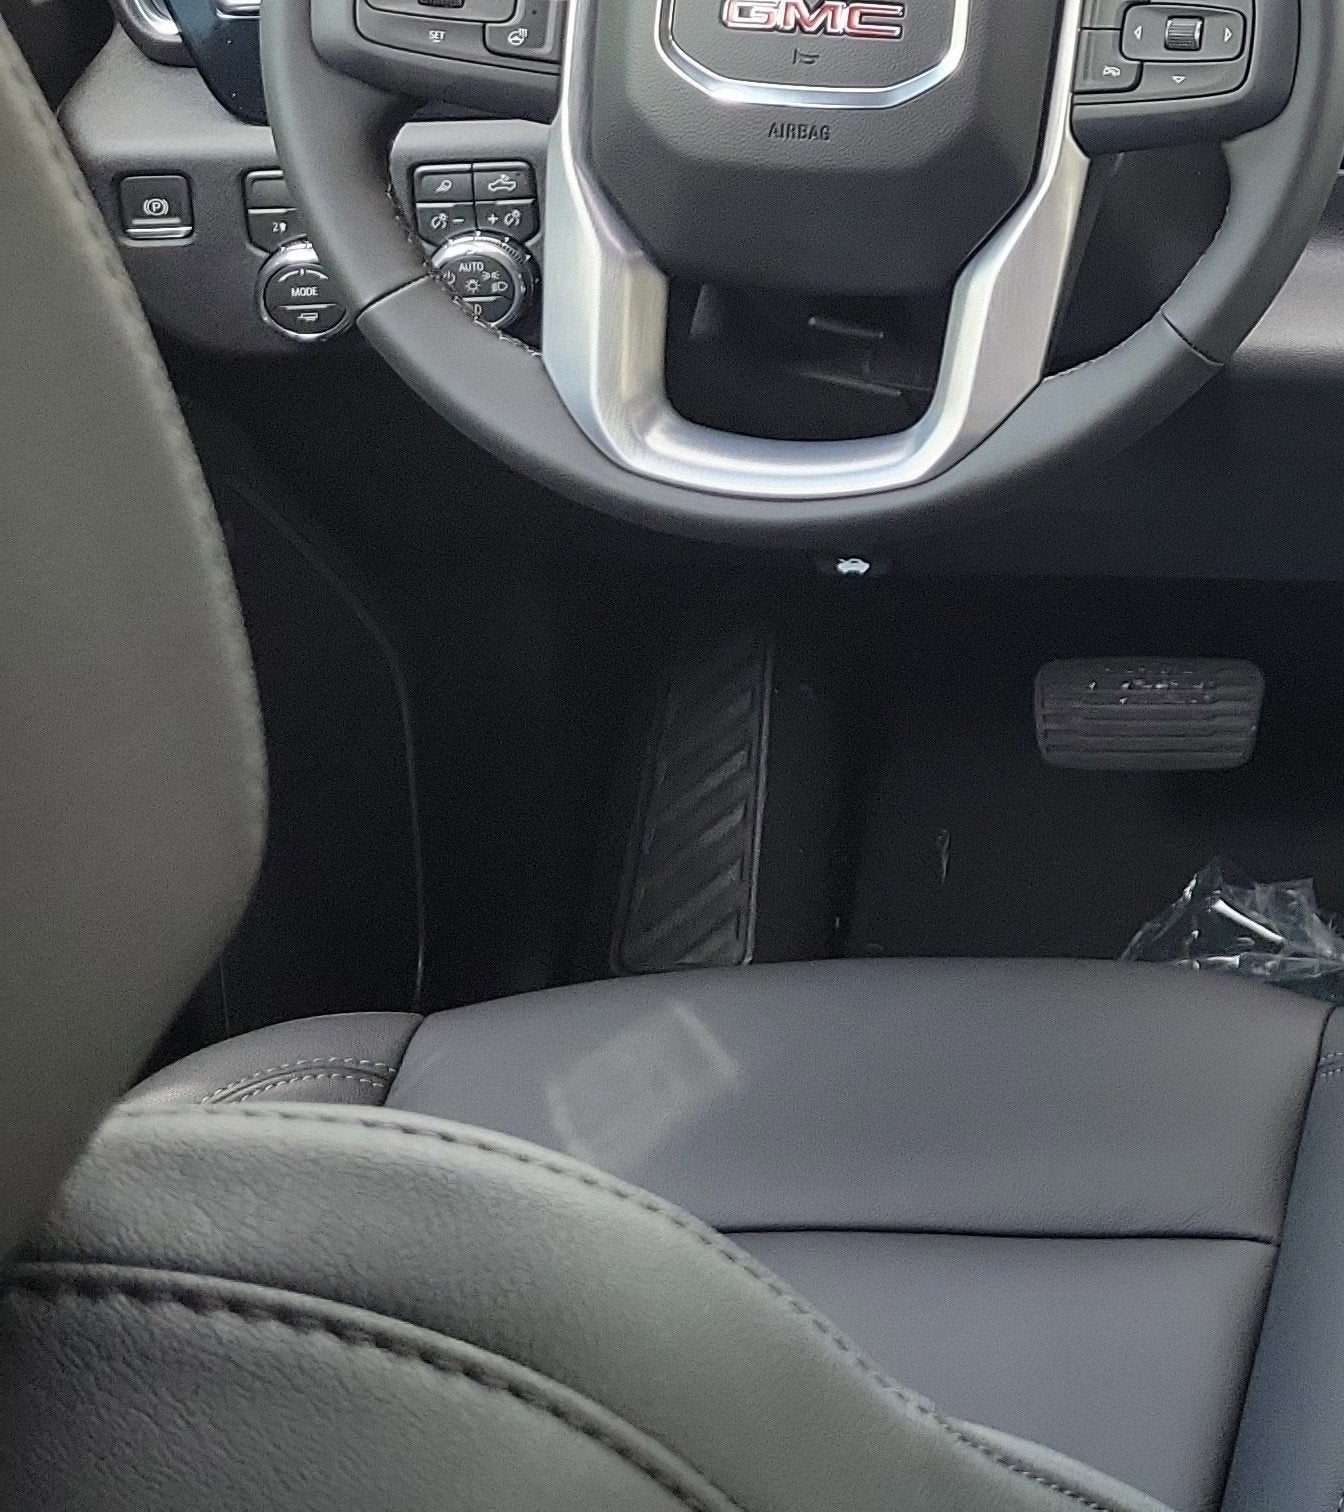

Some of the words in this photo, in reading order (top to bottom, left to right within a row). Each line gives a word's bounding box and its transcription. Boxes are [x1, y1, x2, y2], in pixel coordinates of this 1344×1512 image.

[428, 30, 446, 41] SET
[767, 121, 831, 141] AIRBAG
[458, 262, 485, 273] AUTO
[291, 287, 319, 297] MODE
